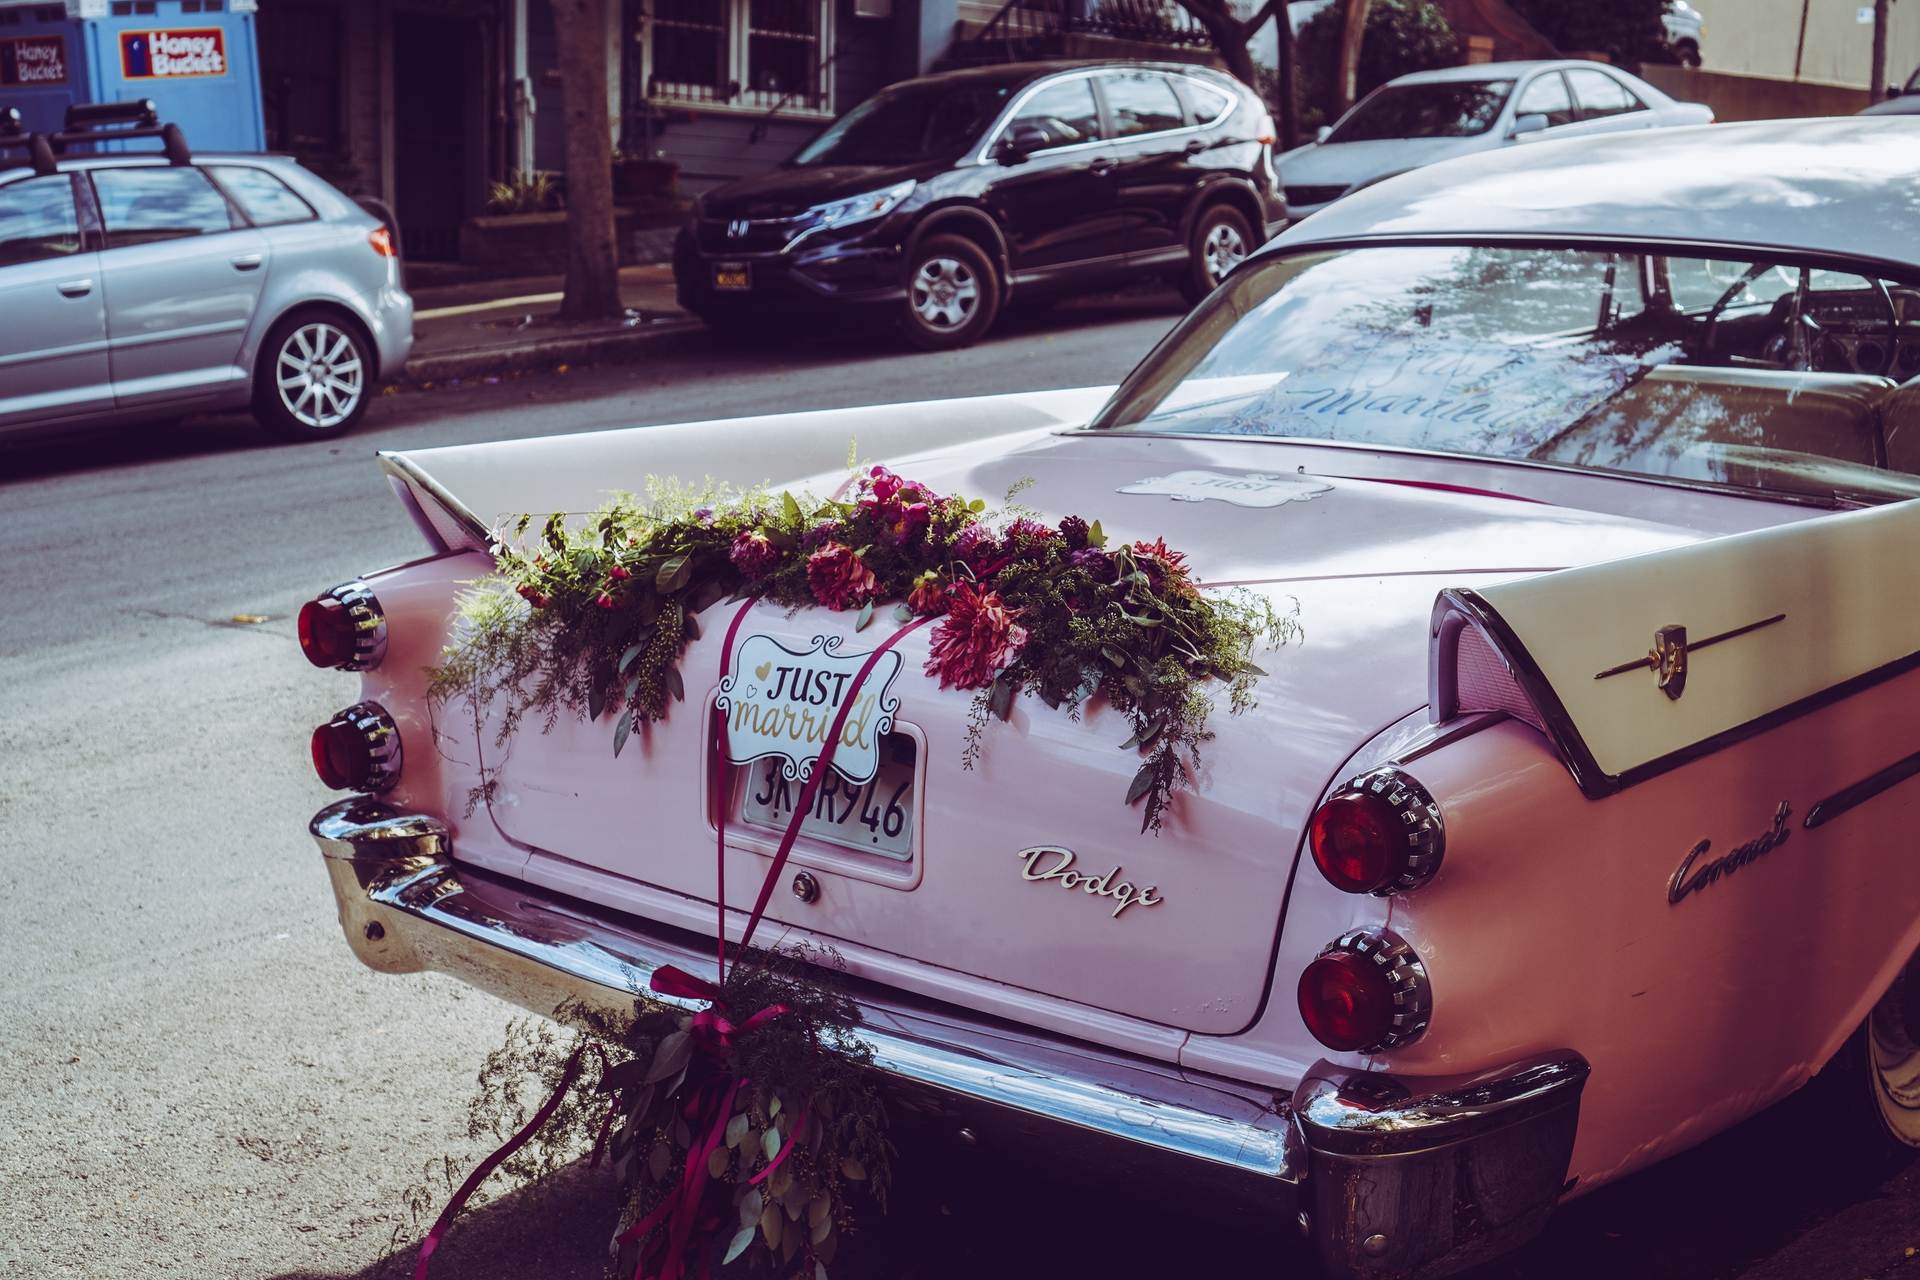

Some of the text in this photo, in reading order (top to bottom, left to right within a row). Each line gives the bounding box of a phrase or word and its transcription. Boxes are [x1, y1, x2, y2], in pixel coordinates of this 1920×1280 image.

[15, 40, 57, 62] Honey
[149, 33, 216, 54] Honey
[152, 54, 224, 75] Bucket
[767, 666, 852, 707] JUST
[734, 694, 869, 750] marrid
[1017, 845, 1164, 919] Dodge
